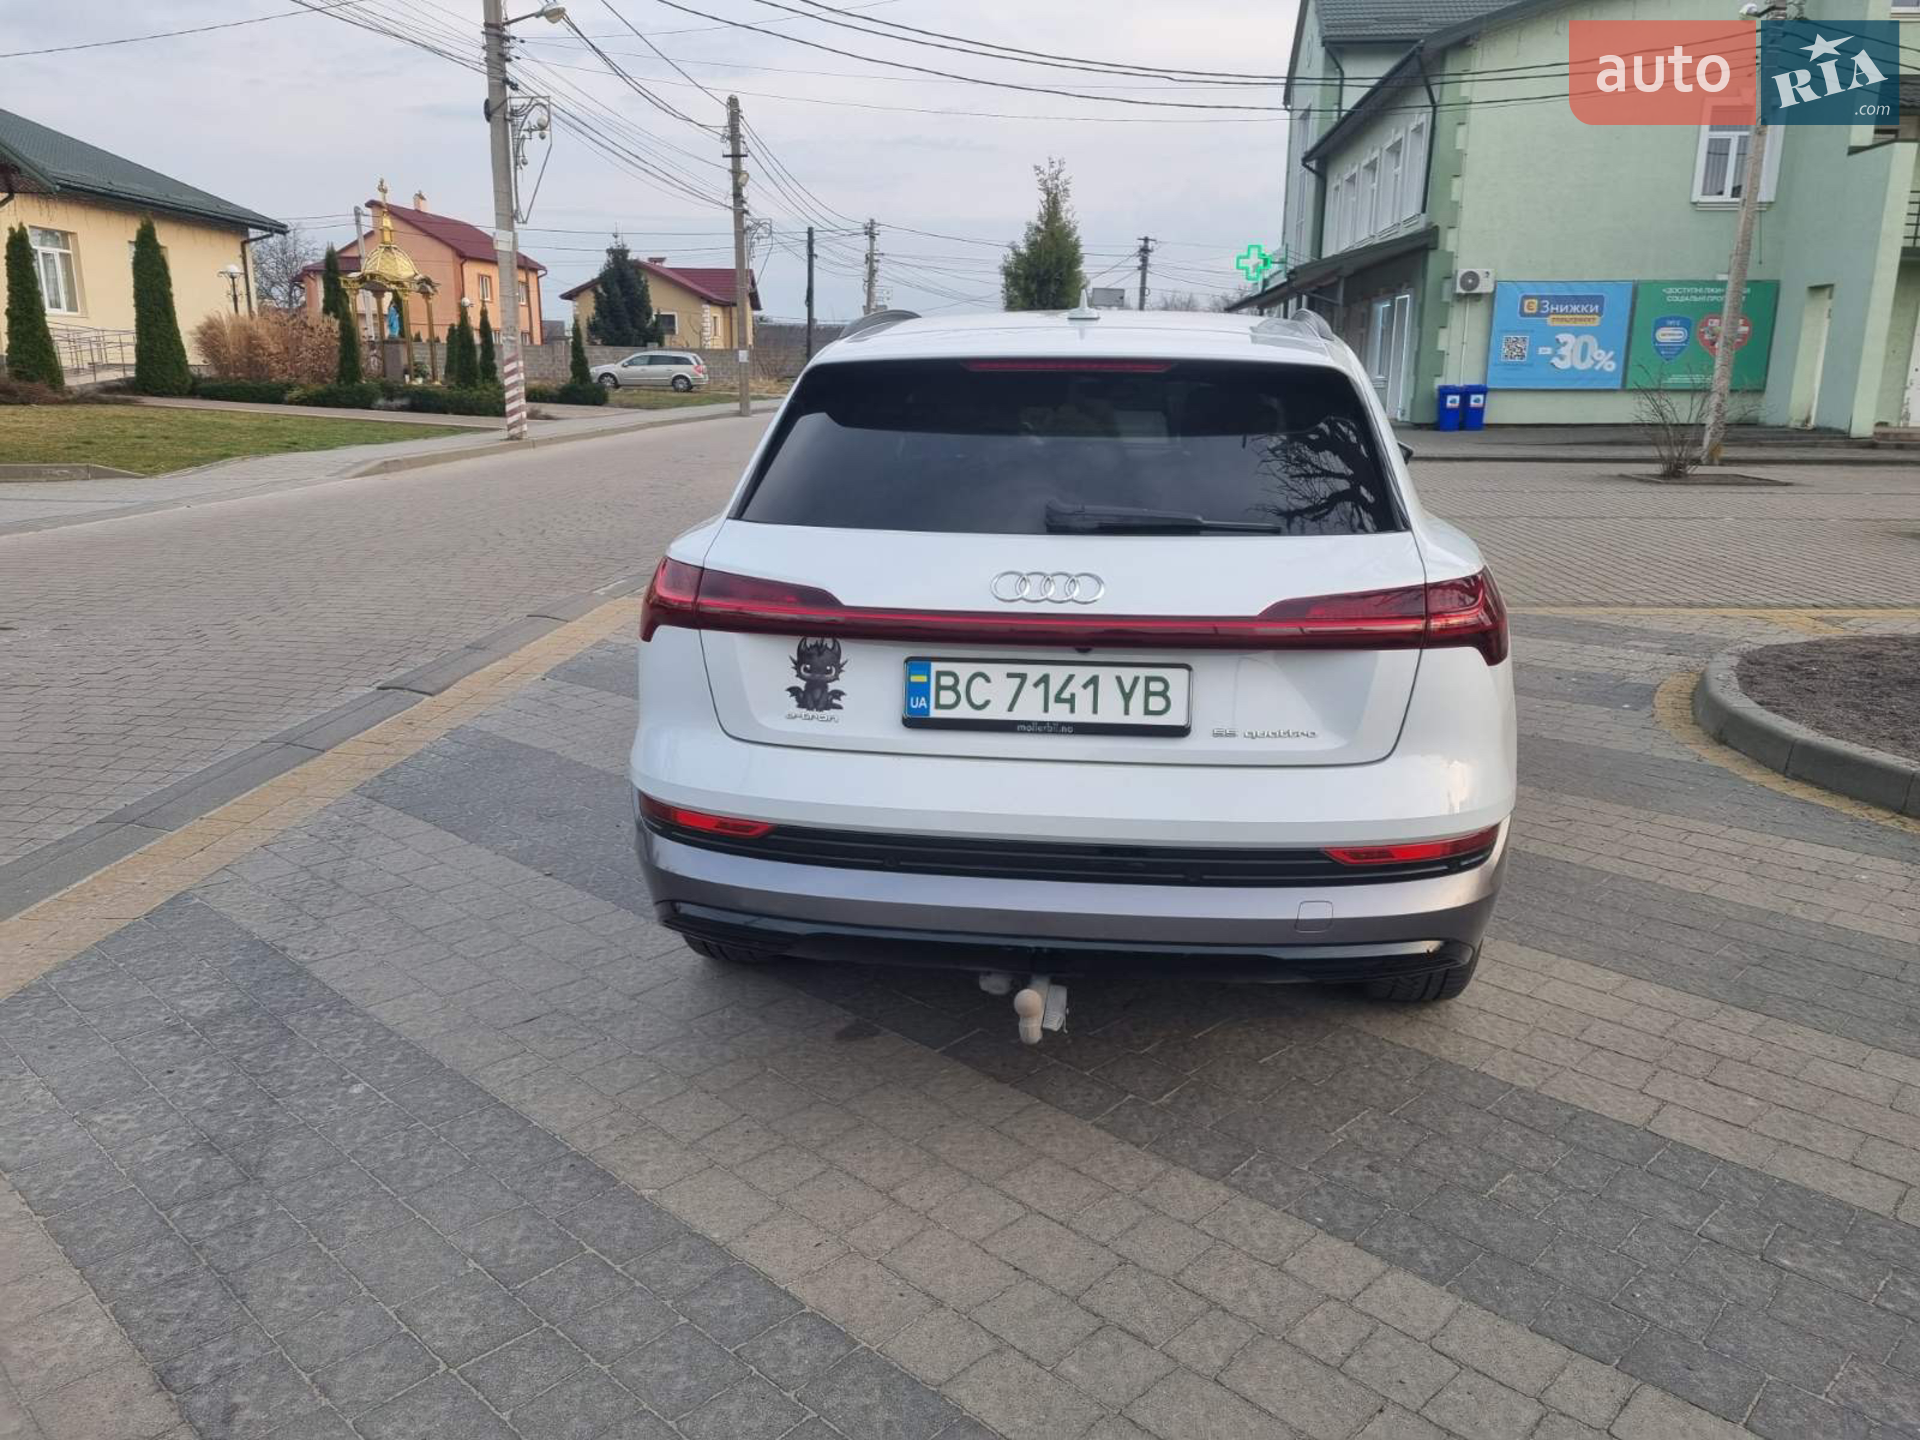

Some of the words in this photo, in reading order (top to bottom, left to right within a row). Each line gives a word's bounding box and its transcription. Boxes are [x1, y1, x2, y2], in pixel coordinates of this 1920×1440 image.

[1540, 300, 1599, 313] Знижки
[934, 670, 992, 711] BC
[1006, 672, 1100, 715] 7141
[1115, 675, 1172, 716] YB
[910, 697, 928, 709] UA
[1243, 729, 1317, 740] quattro
